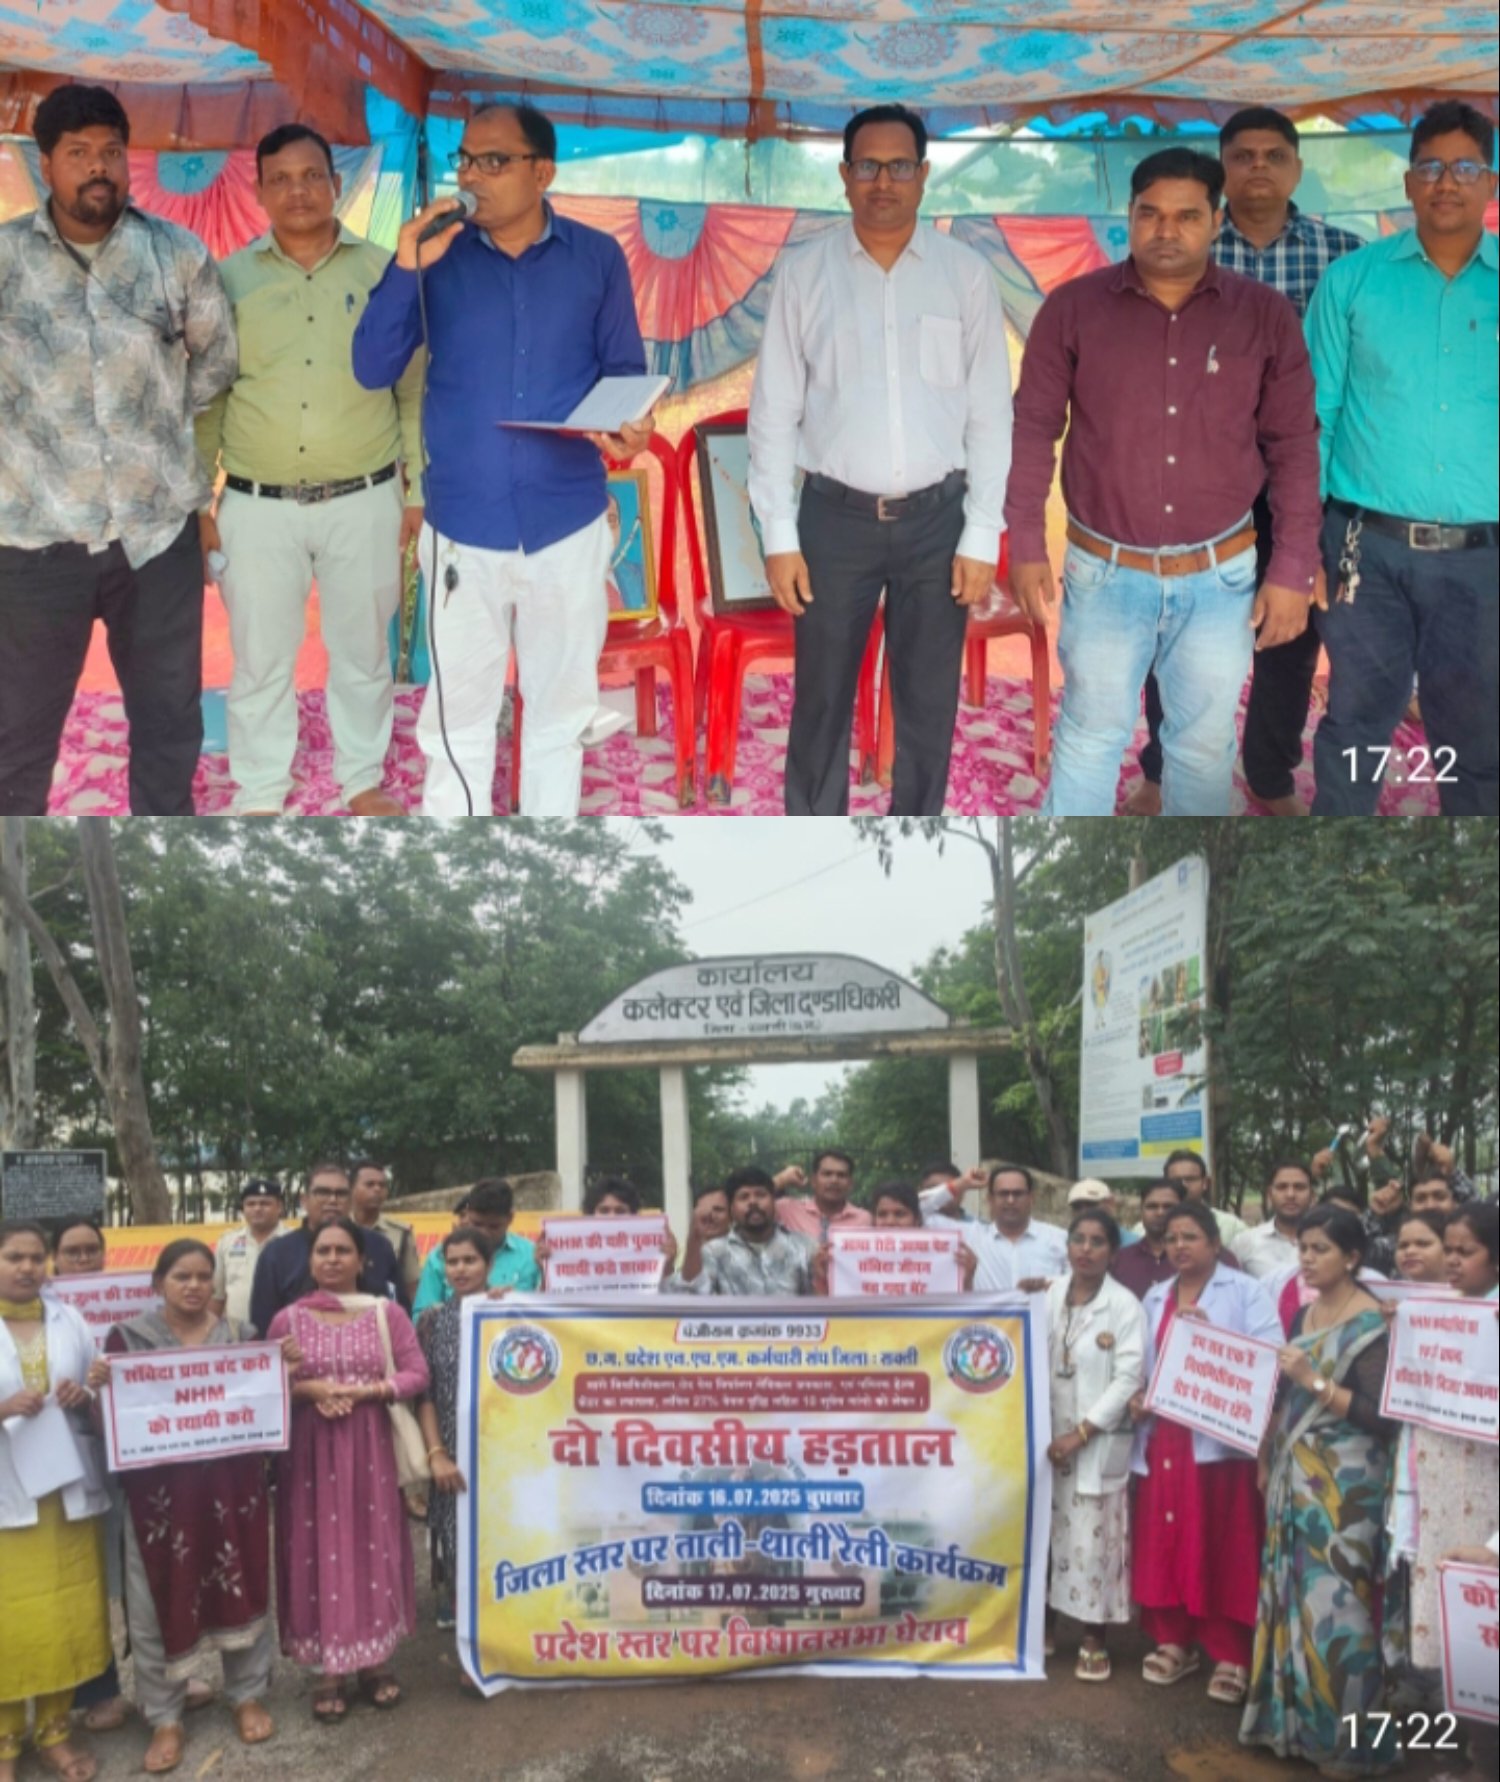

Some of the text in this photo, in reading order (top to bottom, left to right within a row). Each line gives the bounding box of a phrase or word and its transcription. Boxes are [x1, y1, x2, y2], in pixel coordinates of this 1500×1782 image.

[697, 960, 818, 987] कार्यालय
[622, 980, 901, 1021] कलेक्टर एवं जिला दण्डाधिकारी
[787, 1324, 822, 1338] 9933
[241, 1353, 271, 1371] करो
[625, 1346, 660, 1368] प्रदेश
[747, 1346, 803, 1367] कर्मचारी
[174, 1384, 226, 1405] NHM
[148, 1415, 171, 1436] को
[225, 1407, 255, 1424] करो
[548, 1418, 957, 1476] दो दिवसीय हड़ताल
[646, 1486, 862, 1511] दिनांक 16.07.2025 बुधवार
[494, 1553, 568, 1600] जिला
[574, 1544, 625, 1577] स्तर
[632, 1535, 669, 1563] पर
[836, 1520, 890, 1568] रैली
[895, 1543, 1008, 1589] कार्यक्रम
[646, 1579, 703, 1601] दिनांक
[709, 1583, 801, 1601] 17.07.2025
[533, 1613, 969, 1663] प्रदेश स्तर पर विधानसभा घेराव
